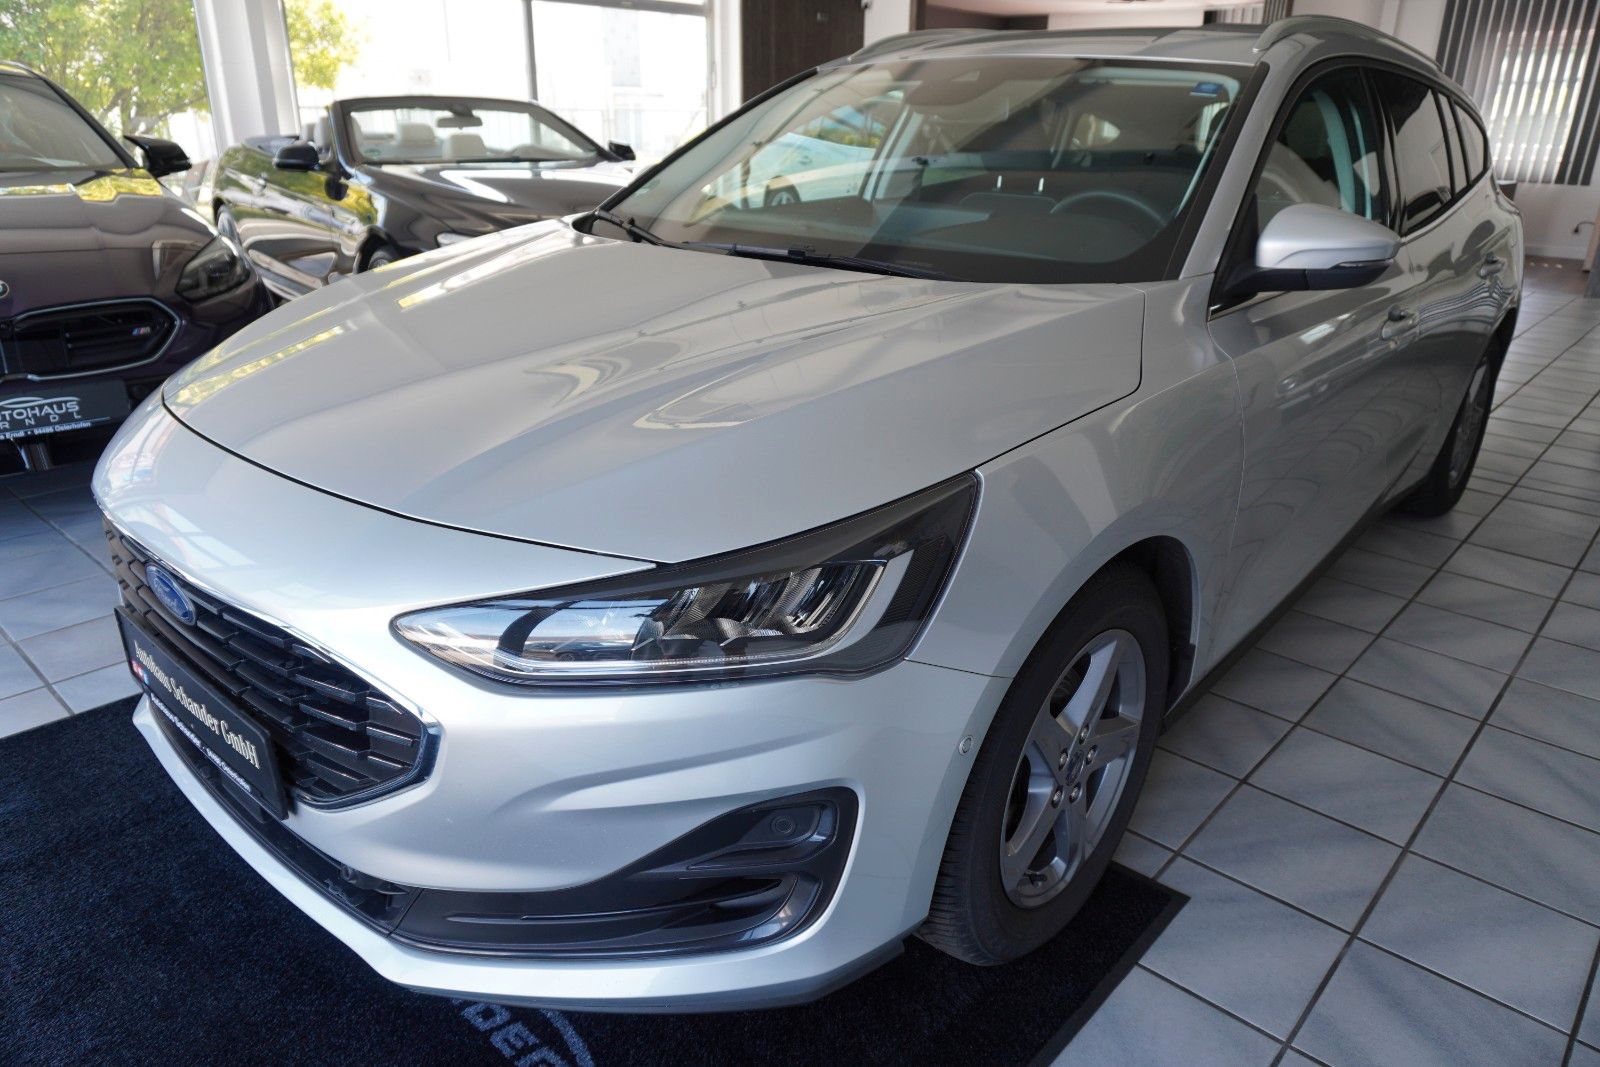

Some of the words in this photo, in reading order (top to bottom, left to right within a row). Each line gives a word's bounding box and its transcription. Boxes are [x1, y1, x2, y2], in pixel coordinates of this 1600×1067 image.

[0, 402, 80, 421] TOHAUS
[134, 639, 173, 693] Autohaus
[170, 677, 221, 735] Schander
[220, 720, 260, 770] GmbH
